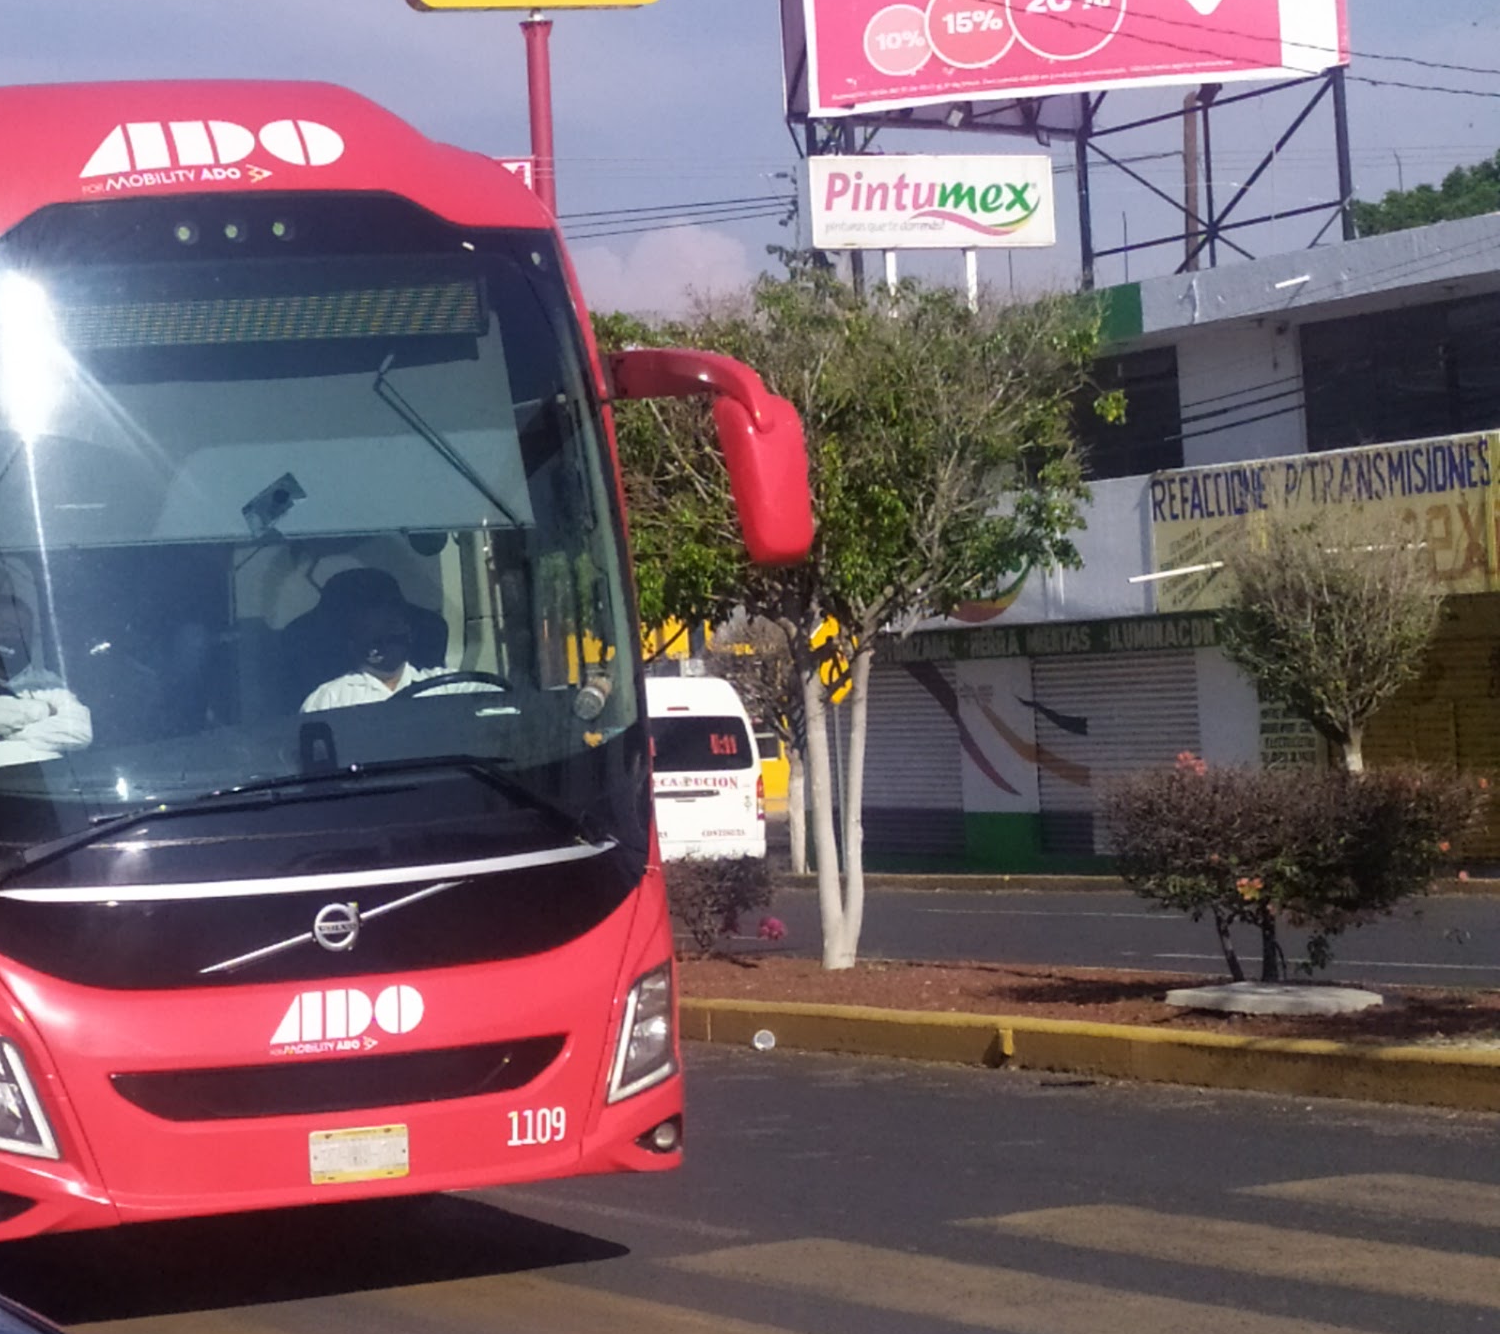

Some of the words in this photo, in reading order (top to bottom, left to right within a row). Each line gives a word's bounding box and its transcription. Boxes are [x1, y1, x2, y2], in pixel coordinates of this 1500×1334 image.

[942, 9, 1004, 35] 15%
[875, 30, 925, 52] 10%
[79, 119, 345, 178] ADO
[105, 170, 196, 192] MOBILITY
[201, 168, 242, 181] ADO
[824, 170, 1032, 214] Pintumex
[868, 221, 885, 234] que
[1151, 464, 1276, 522] REFACCIONE
[269, 984, 425, 1045] ADO
[336, 1040, 360, 1051] ADO
[507, 1106, 567, 1147] 1109
